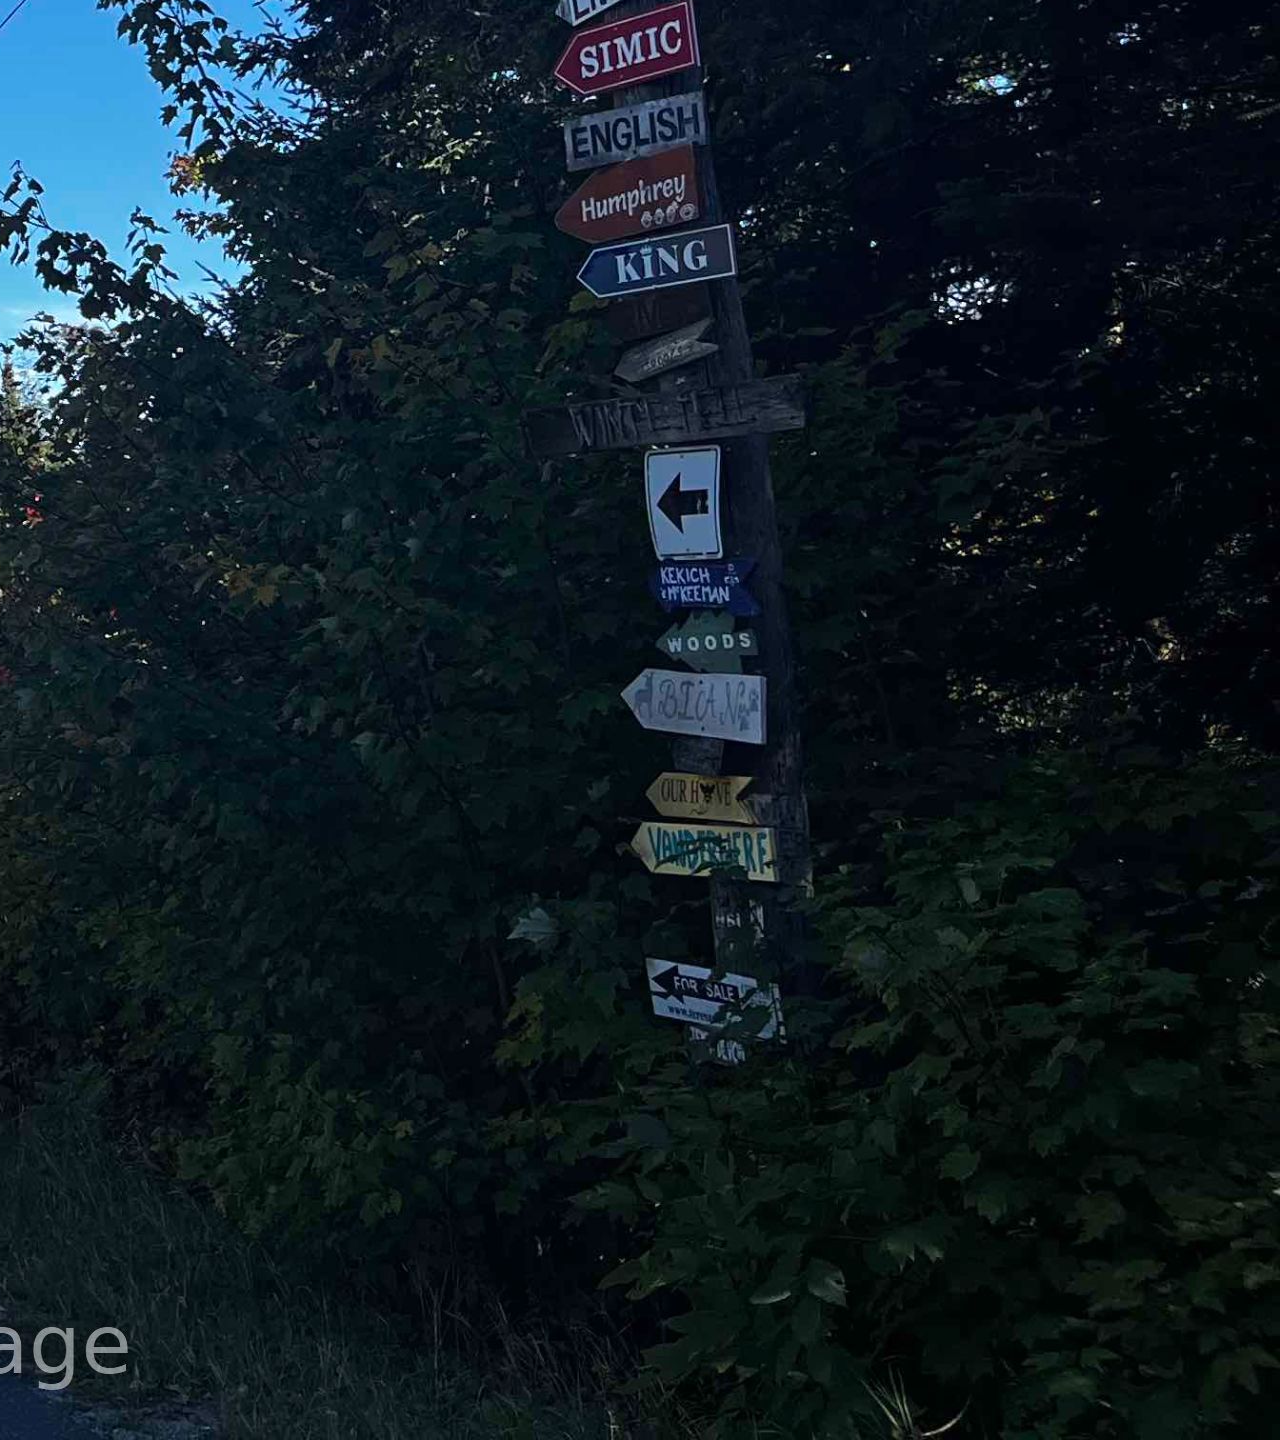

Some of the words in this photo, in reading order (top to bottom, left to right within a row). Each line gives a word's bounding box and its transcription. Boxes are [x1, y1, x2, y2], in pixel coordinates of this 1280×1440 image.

[579, 20, 682, 78] SIMIC
[571, 103, 700, 159] ENGLISH
[581, 174, 686, 222] Humphrey
[615, 240, 708, 283] KING
[660, 566, 710, 585] KEKICH
[667, 632, 752, 653] WOODS
[660, 778, 687, 803] OUR
[673, 976, 698, 993] FOR
[705, 984, 735, 1002] SALE
